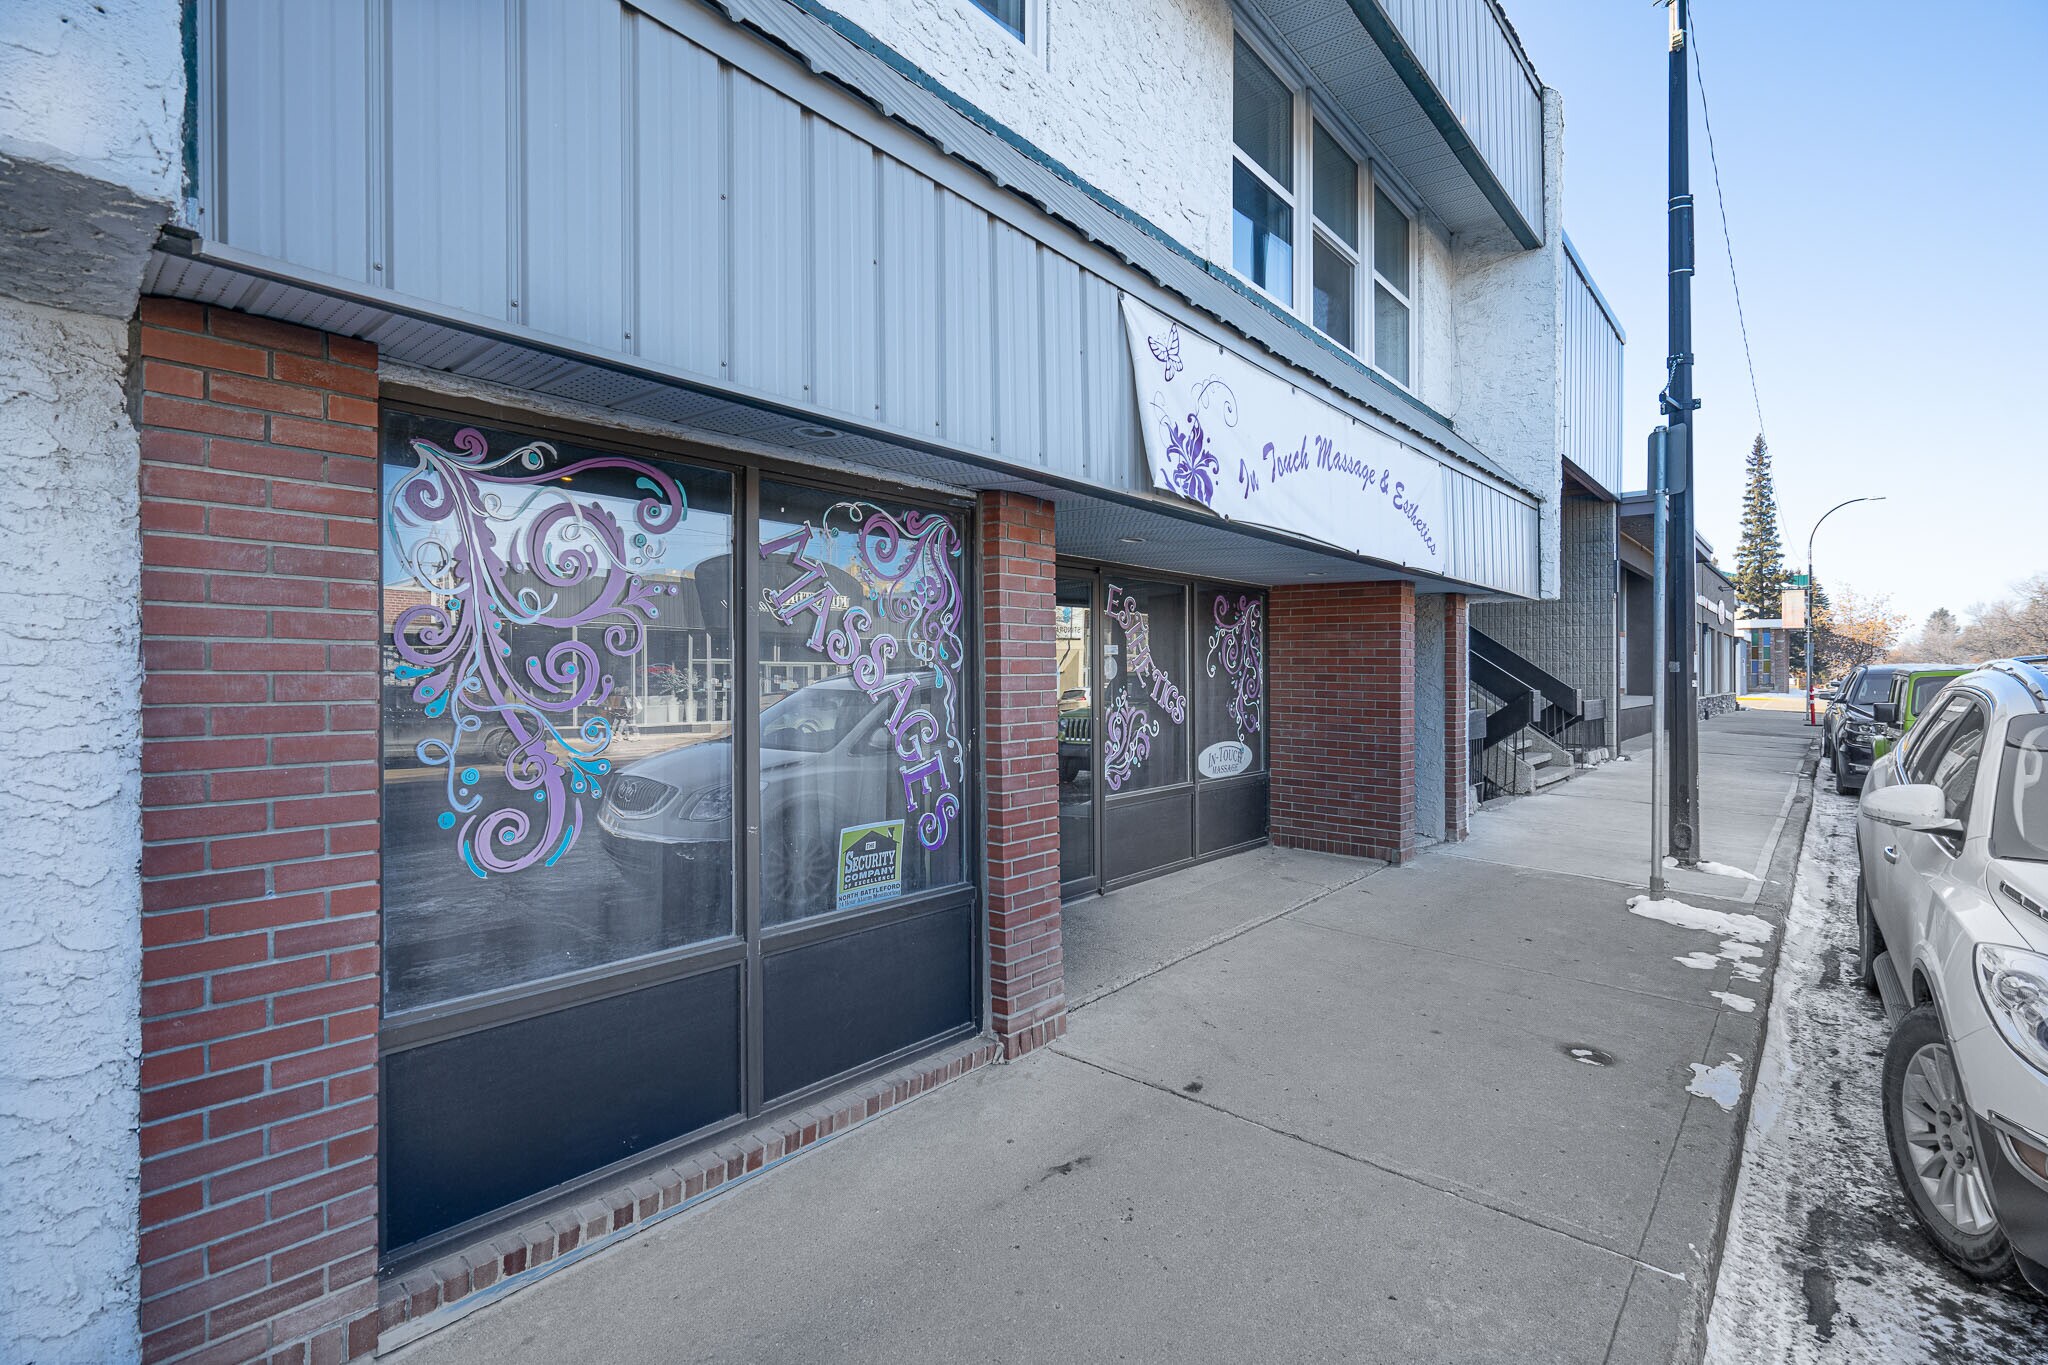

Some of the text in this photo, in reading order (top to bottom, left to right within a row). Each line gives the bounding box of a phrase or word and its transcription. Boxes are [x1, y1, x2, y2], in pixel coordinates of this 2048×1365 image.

[1239, 434, 1436, 556] In Touch Massage & Esthetics
[1104, 583, 1187, 725] ESTHETICS
[758, 520, 960, 851] MASSAGES
[1208, 745, 1244, 768] IN-TOUCH
[845, 850, 896, 874] SECURITY
[844, 866, 895, 883] COMPANY
[839, 883, 901, 902] NORTH BATTLEFORD
